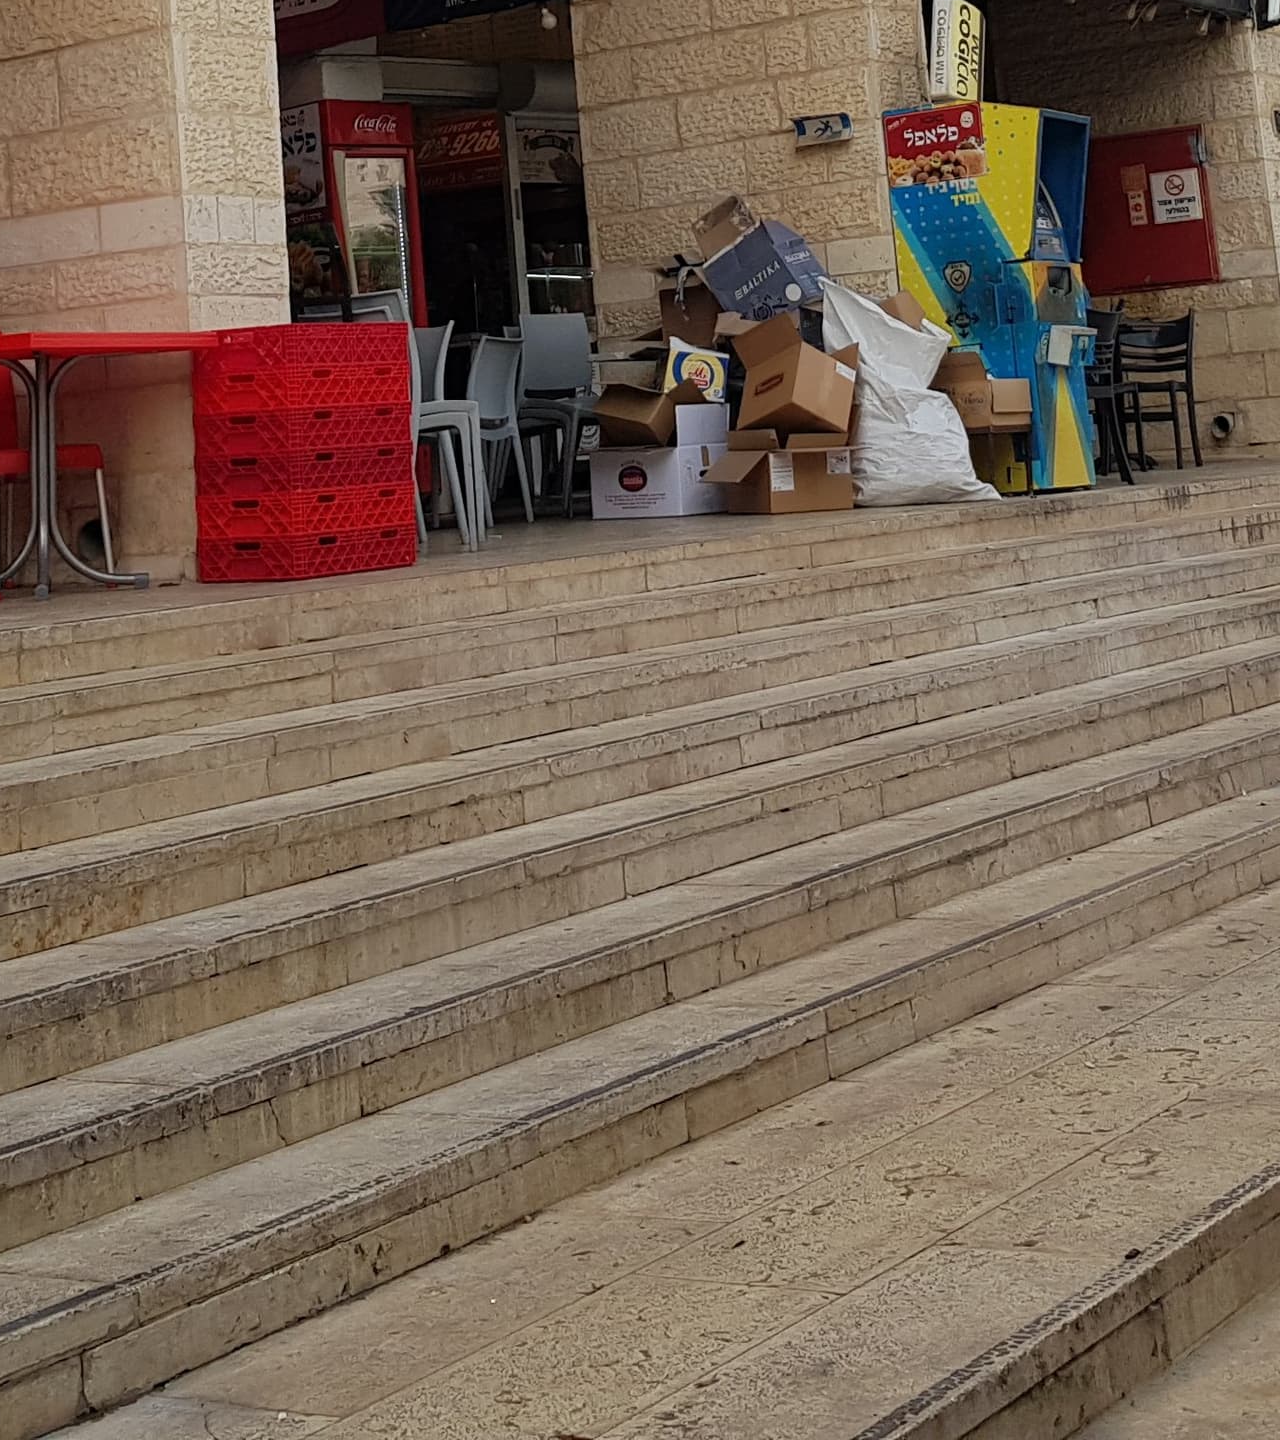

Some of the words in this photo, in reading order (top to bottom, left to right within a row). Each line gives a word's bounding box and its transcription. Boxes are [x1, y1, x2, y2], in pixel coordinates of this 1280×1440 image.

[969, 34, 980, 81] ATM
[935, 60, 946, 85] ATM
[353, 113, 402, 134] Coca-Cola
[903, 123, 959, 148] פלאפל
[740, 260, 781, 297] BALTIKA
